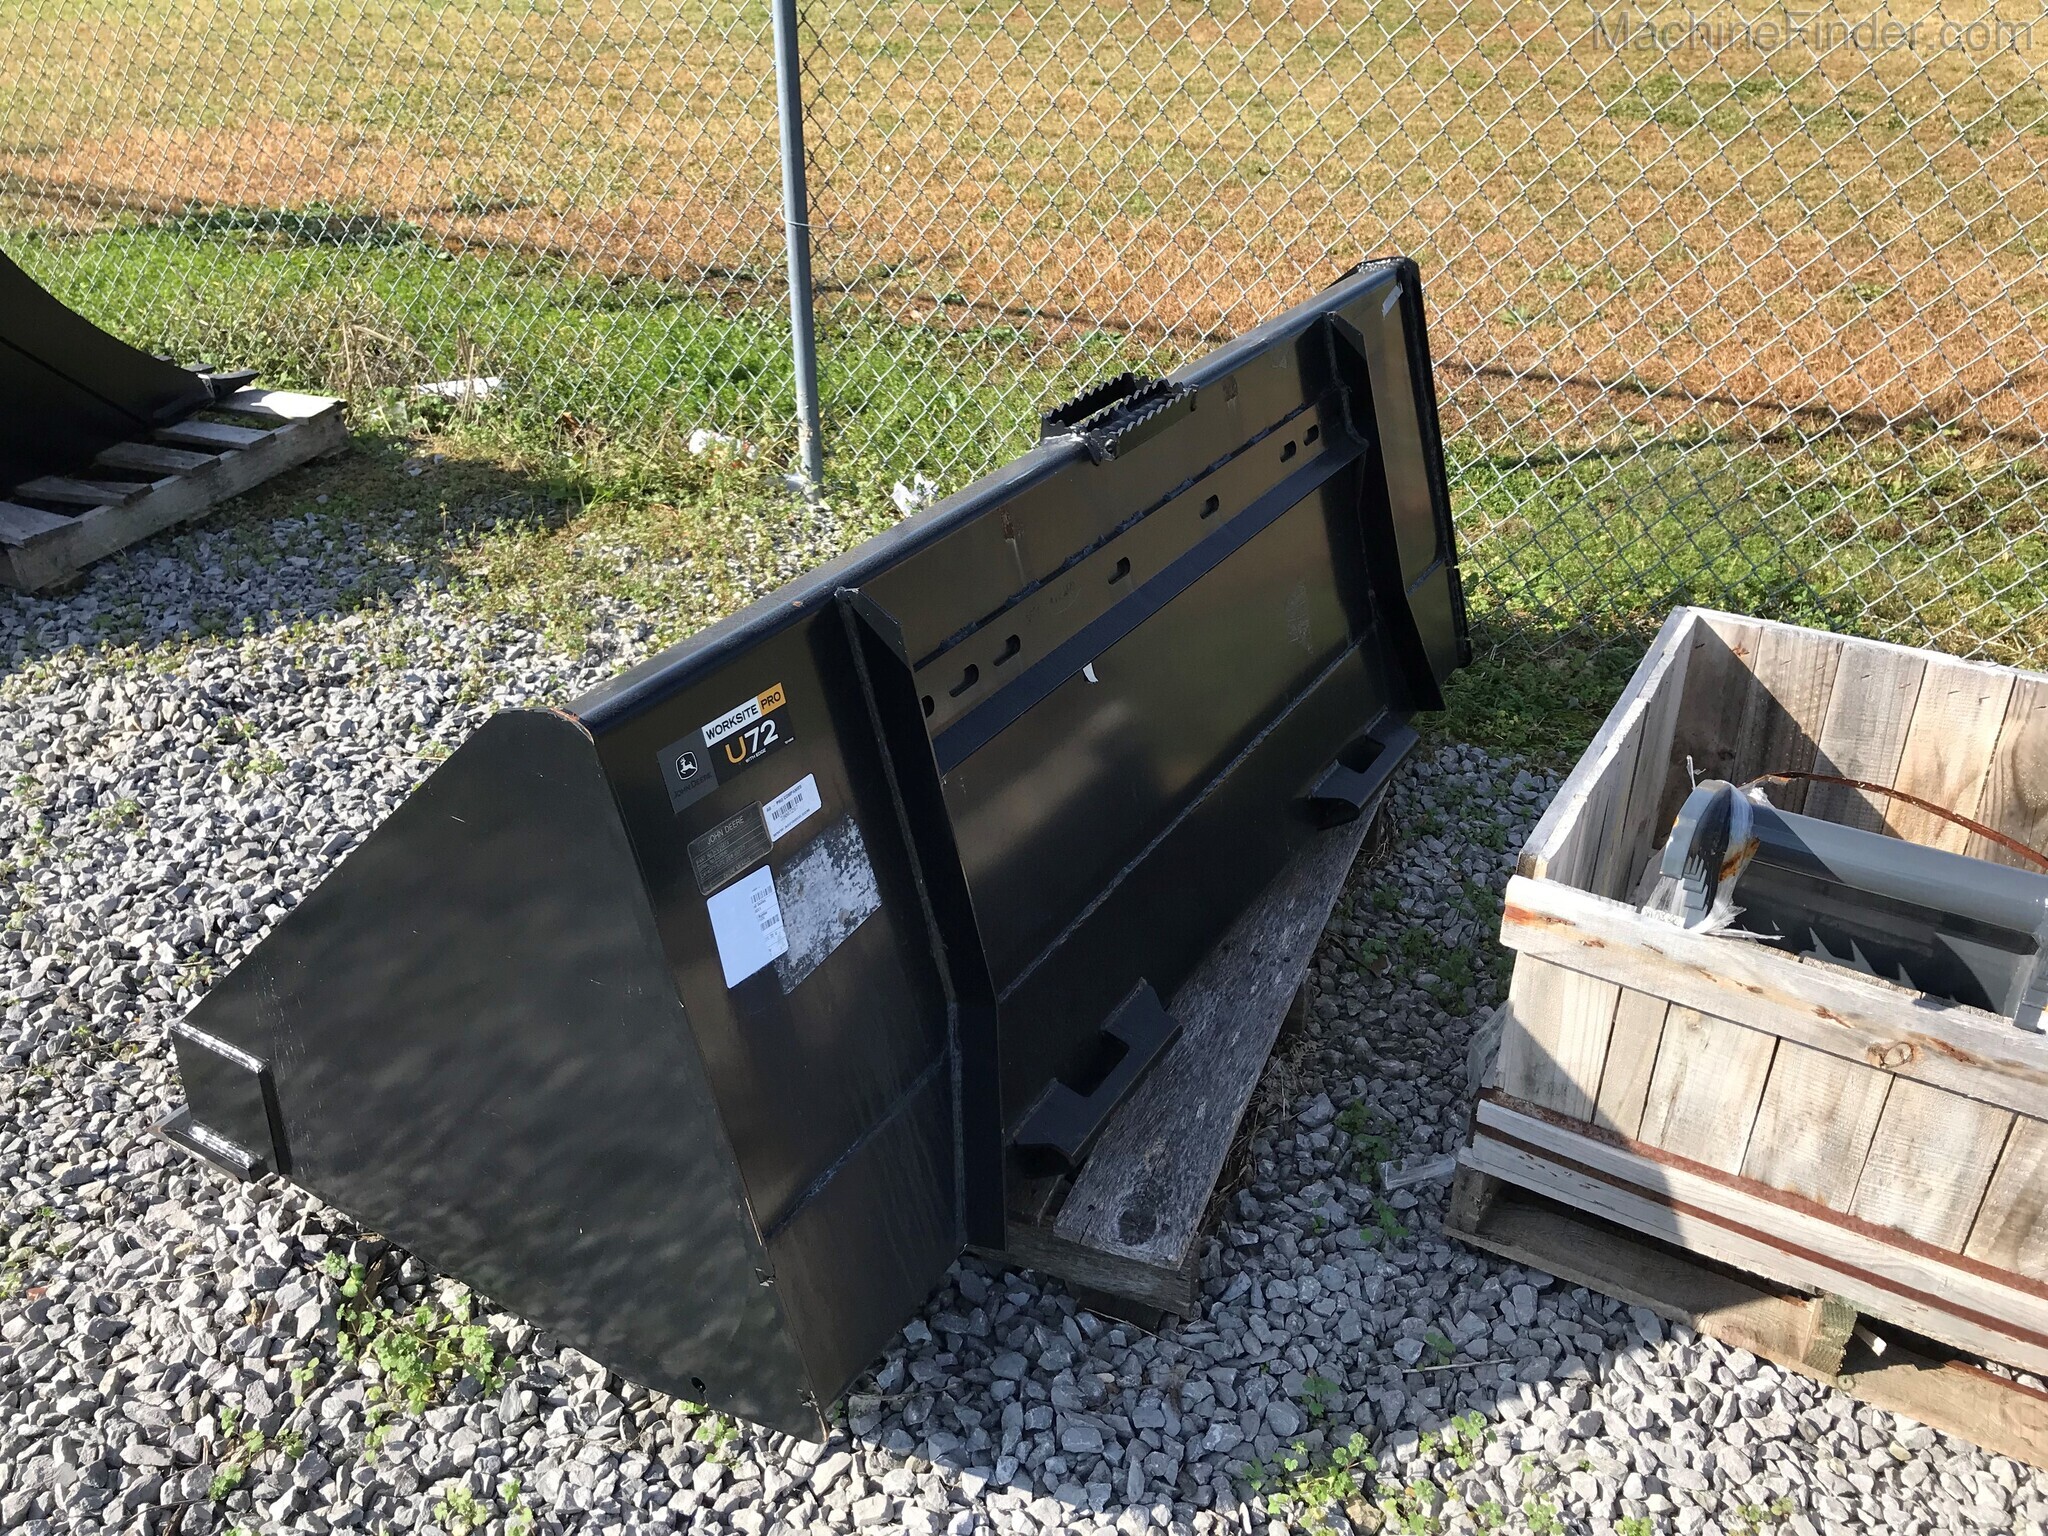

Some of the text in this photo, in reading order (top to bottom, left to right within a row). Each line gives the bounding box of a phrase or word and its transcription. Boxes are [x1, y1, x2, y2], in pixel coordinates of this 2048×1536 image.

[705, 691, 781, 740] WORKSITE PRO
[725, 719, 779, 764] U72
[707, 815, 745, 845] JOHN DEERE
